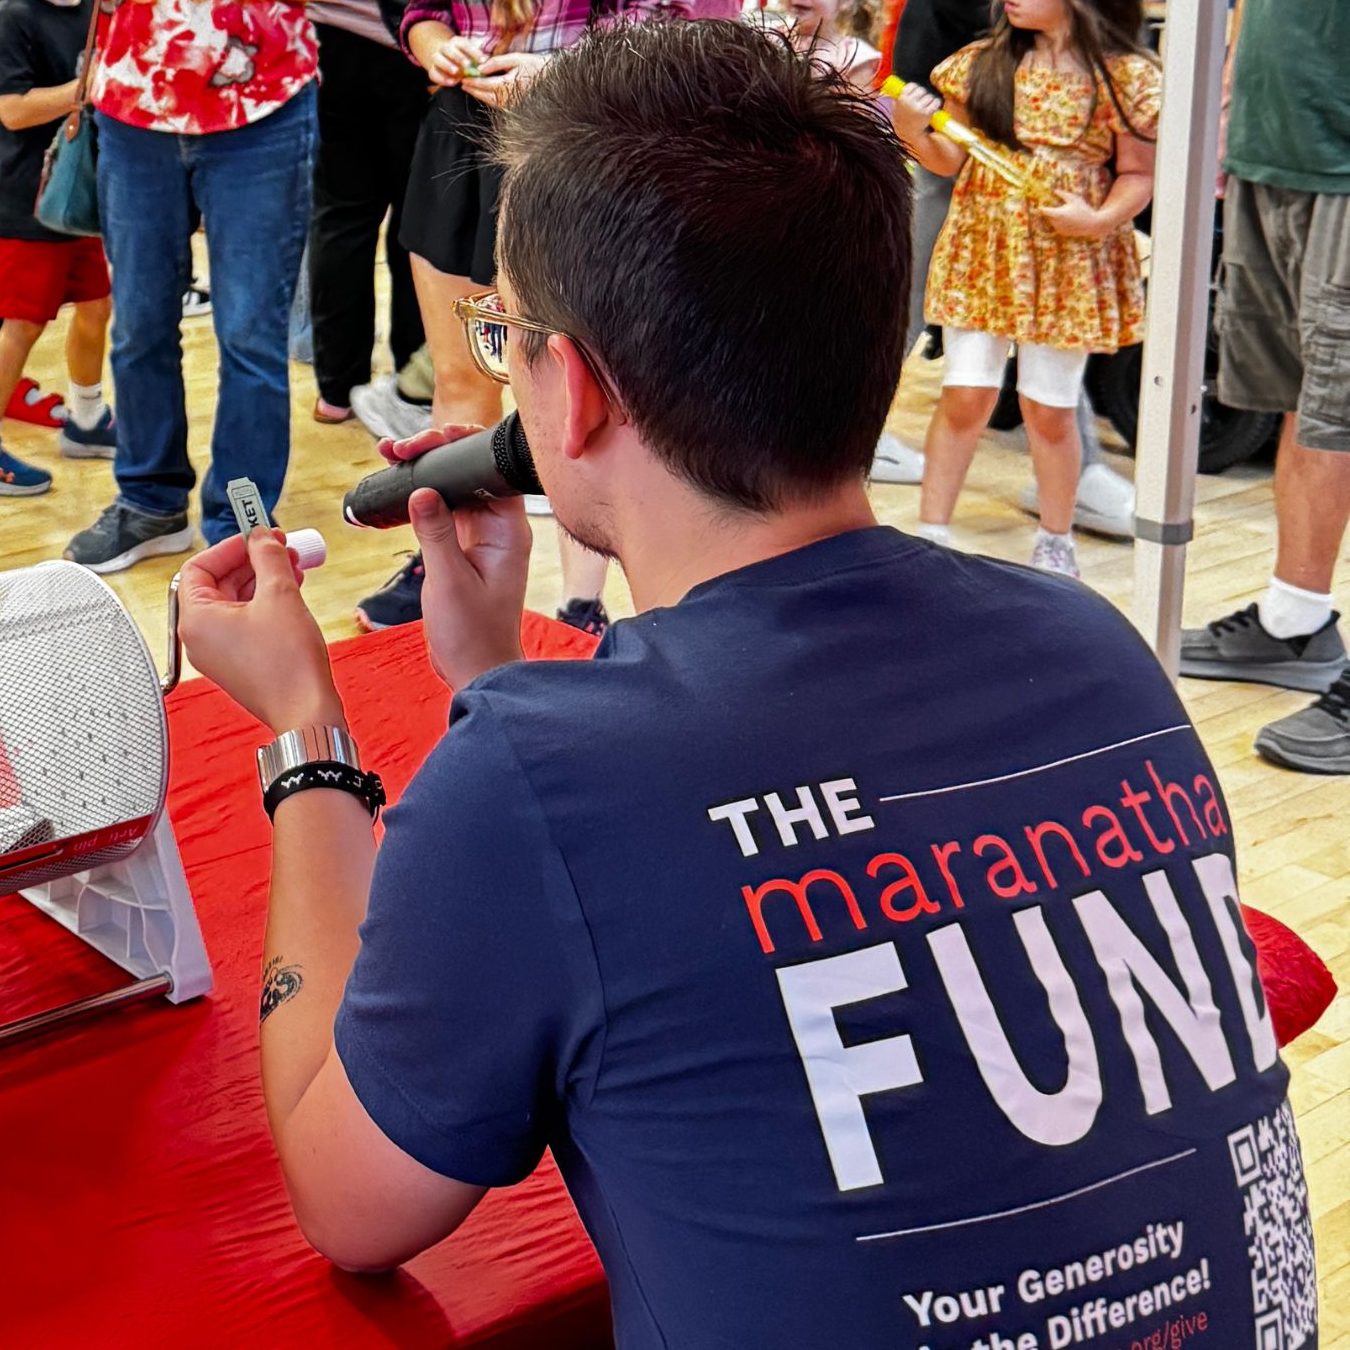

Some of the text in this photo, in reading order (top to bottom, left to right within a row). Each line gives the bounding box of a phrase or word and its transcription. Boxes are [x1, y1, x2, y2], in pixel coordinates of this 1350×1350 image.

[707, 777, 875, 857] THE
[741, 760, 1228, 954] maranatha
[902, 1220, 1184, 1327] Your Generosity
[1048, 1258, 1211, 1350] Difference!
